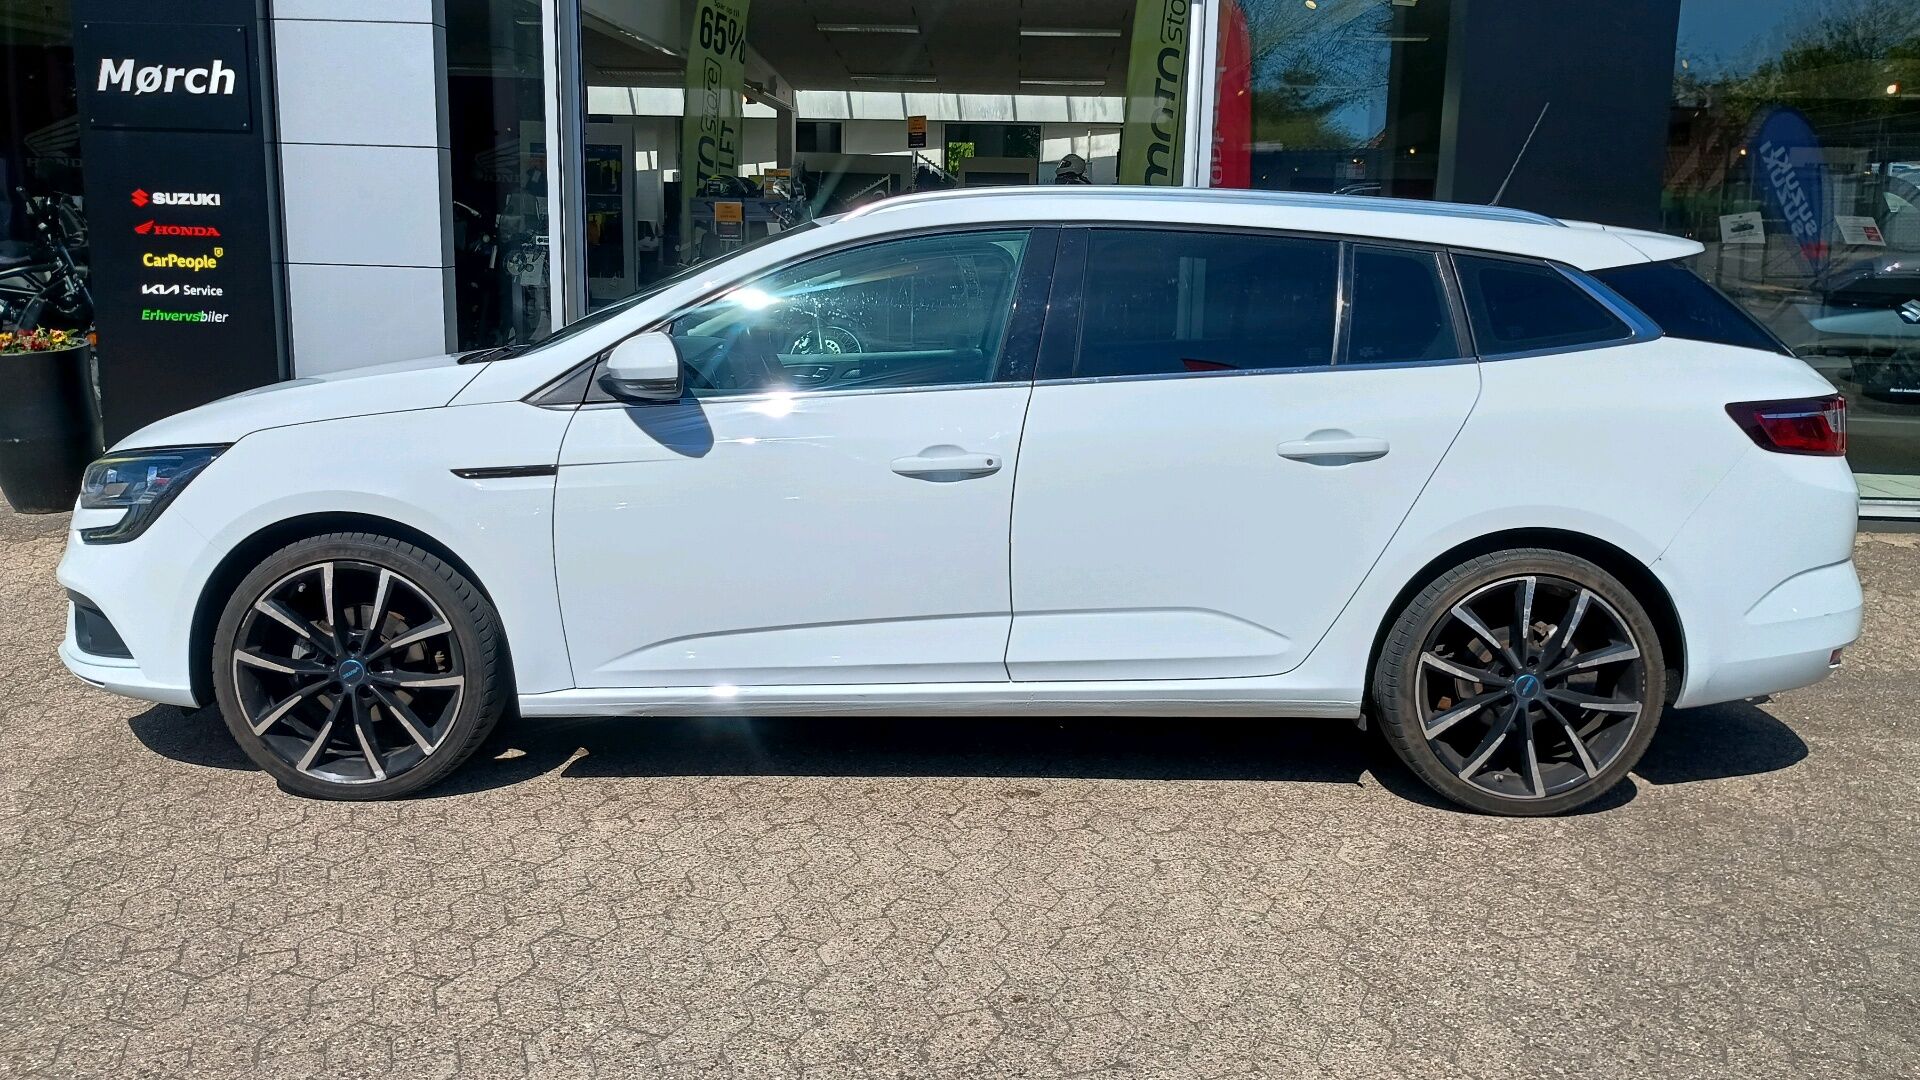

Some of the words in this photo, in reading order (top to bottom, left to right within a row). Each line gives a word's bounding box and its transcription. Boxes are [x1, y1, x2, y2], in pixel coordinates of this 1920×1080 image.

[700, 6, 746, 64] 65%
[97, 58, 235, 96] Mørch
[718, 121, 735, 173] LET
[152, 192, 221, 206] SUZUKI
[153, 225, 221, 237] HONDA
[143, 253, 216, 271] CarPeople
[183, 285, 223, 297] Service
[141, 309, 229, 323] Erhvervsbiler
